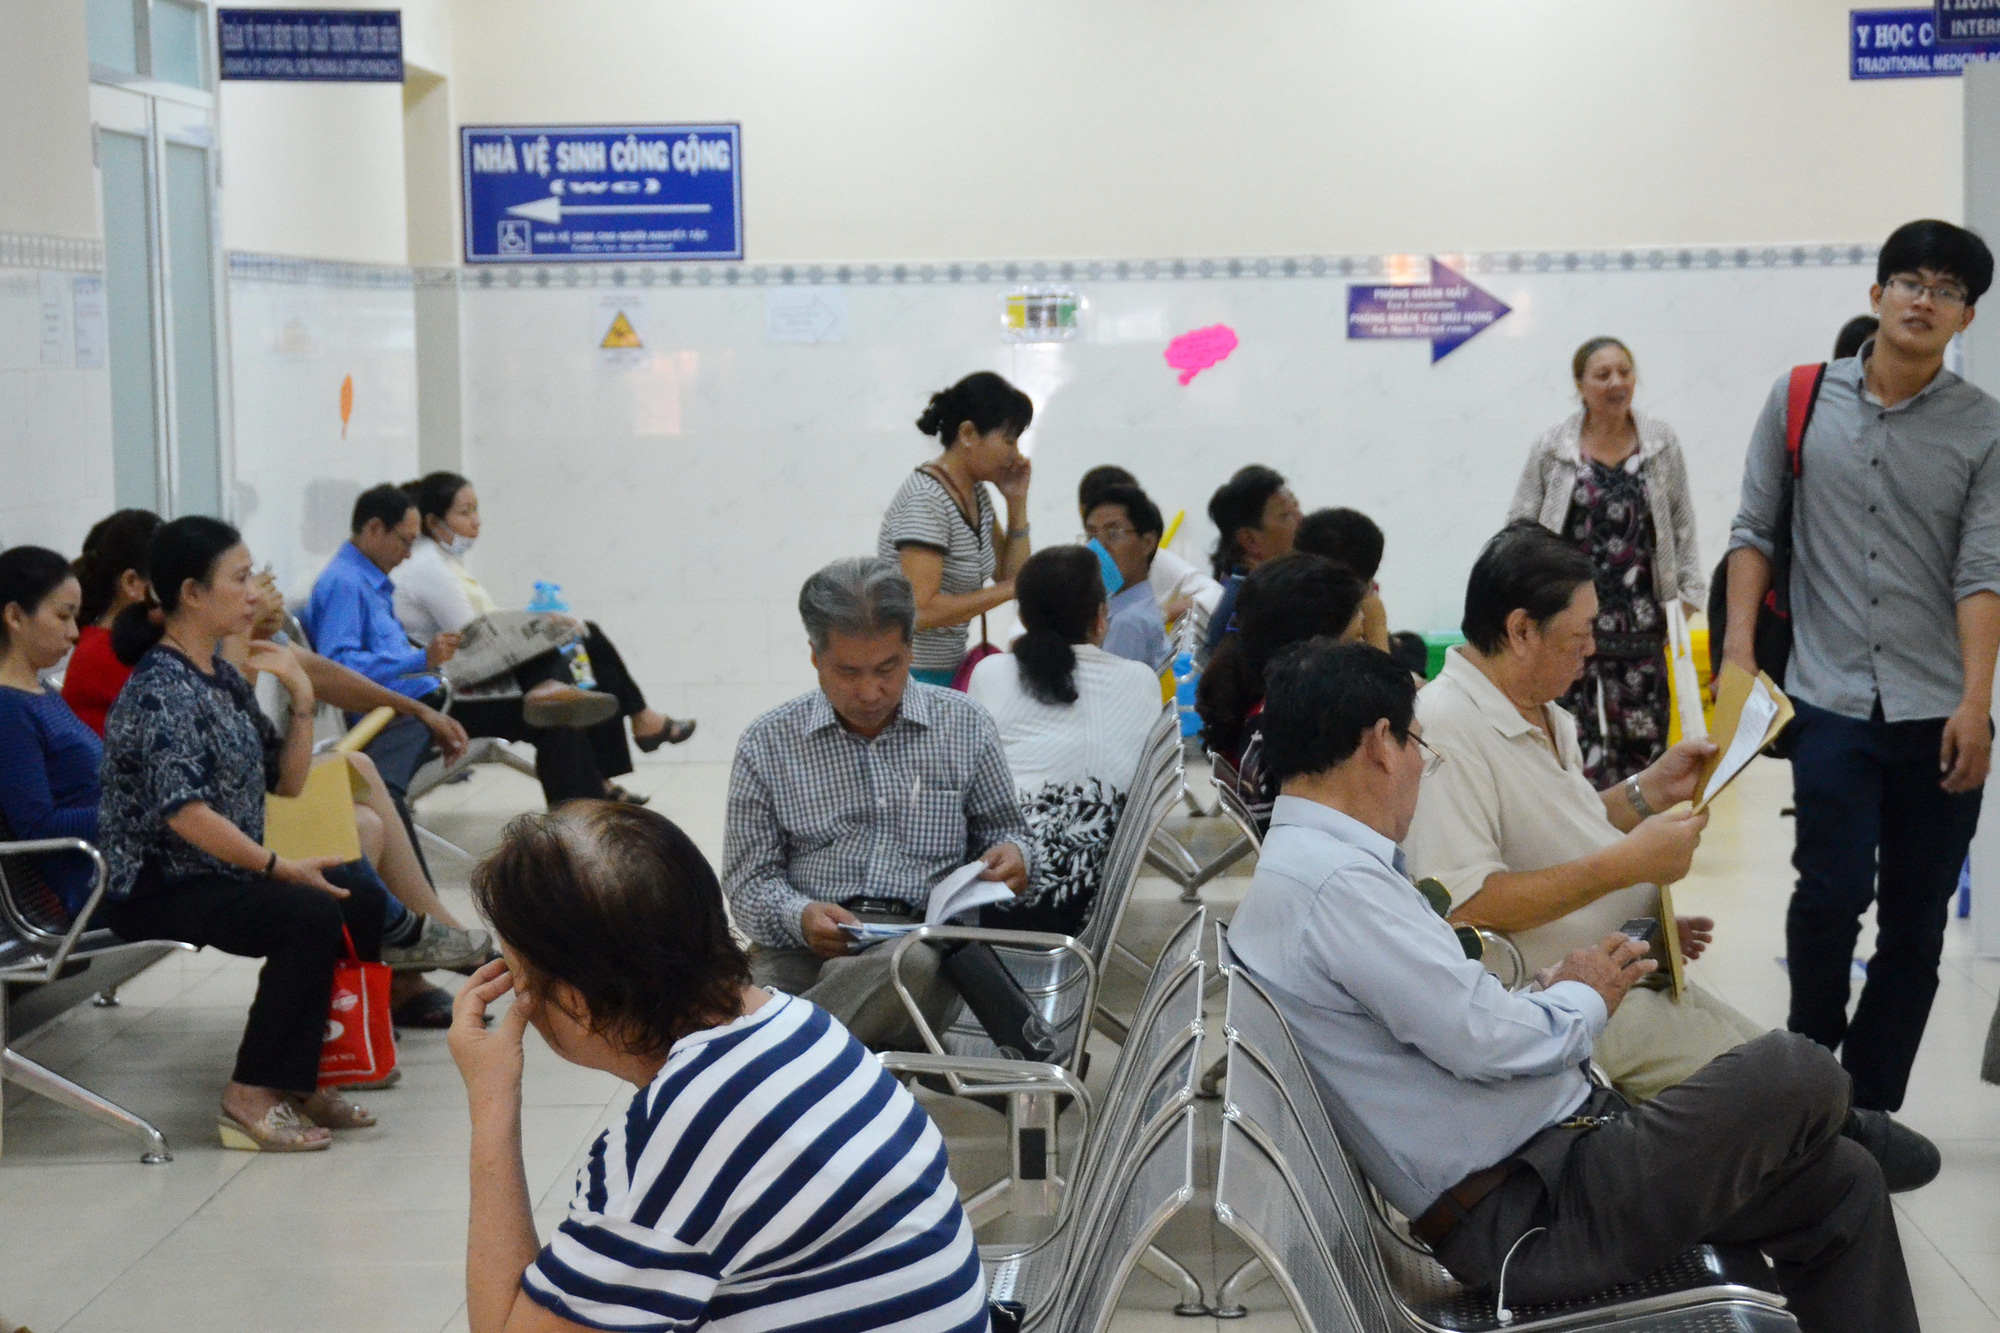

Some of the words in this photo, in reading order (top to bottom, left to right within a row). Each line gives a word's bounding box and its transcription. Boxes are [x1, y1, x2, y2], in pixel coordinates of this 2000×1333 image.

[1856, 25, 1870, 49] Y
[1874, 23, 1914, 52] HỌC
[1857, 55, 1931, 73] TRADITIONAL
[473, 134, 518, 173] NHÀ
[521, 134, 550, 178] VỆ
[556, 141, 607, 173] SINH
[611, 132, 670, 173] CÔNG
[672, 132, 731, 177] CỘNG
